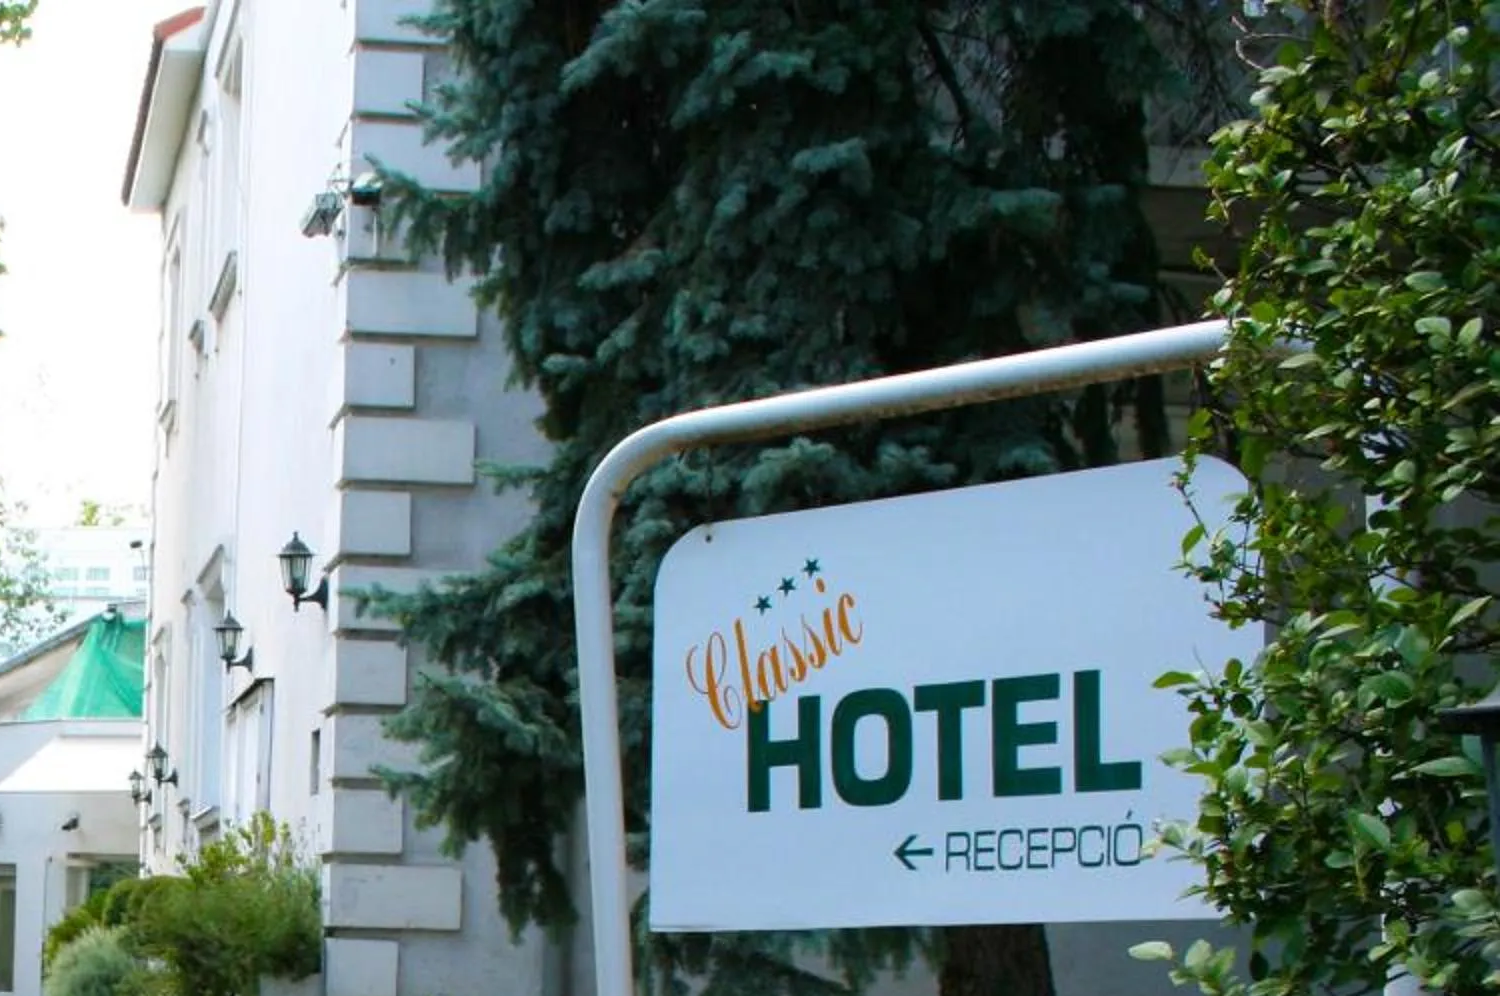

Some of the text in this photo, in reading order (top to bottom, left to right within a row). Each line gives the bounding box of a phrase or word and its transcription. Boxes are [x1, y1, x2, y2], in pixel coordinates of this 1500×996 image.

[687, 579, 862, 729] Classic
[747, 670, 1142, 812] HOTEL
[945, 809, 1143, 871] RECEPCIÓ
